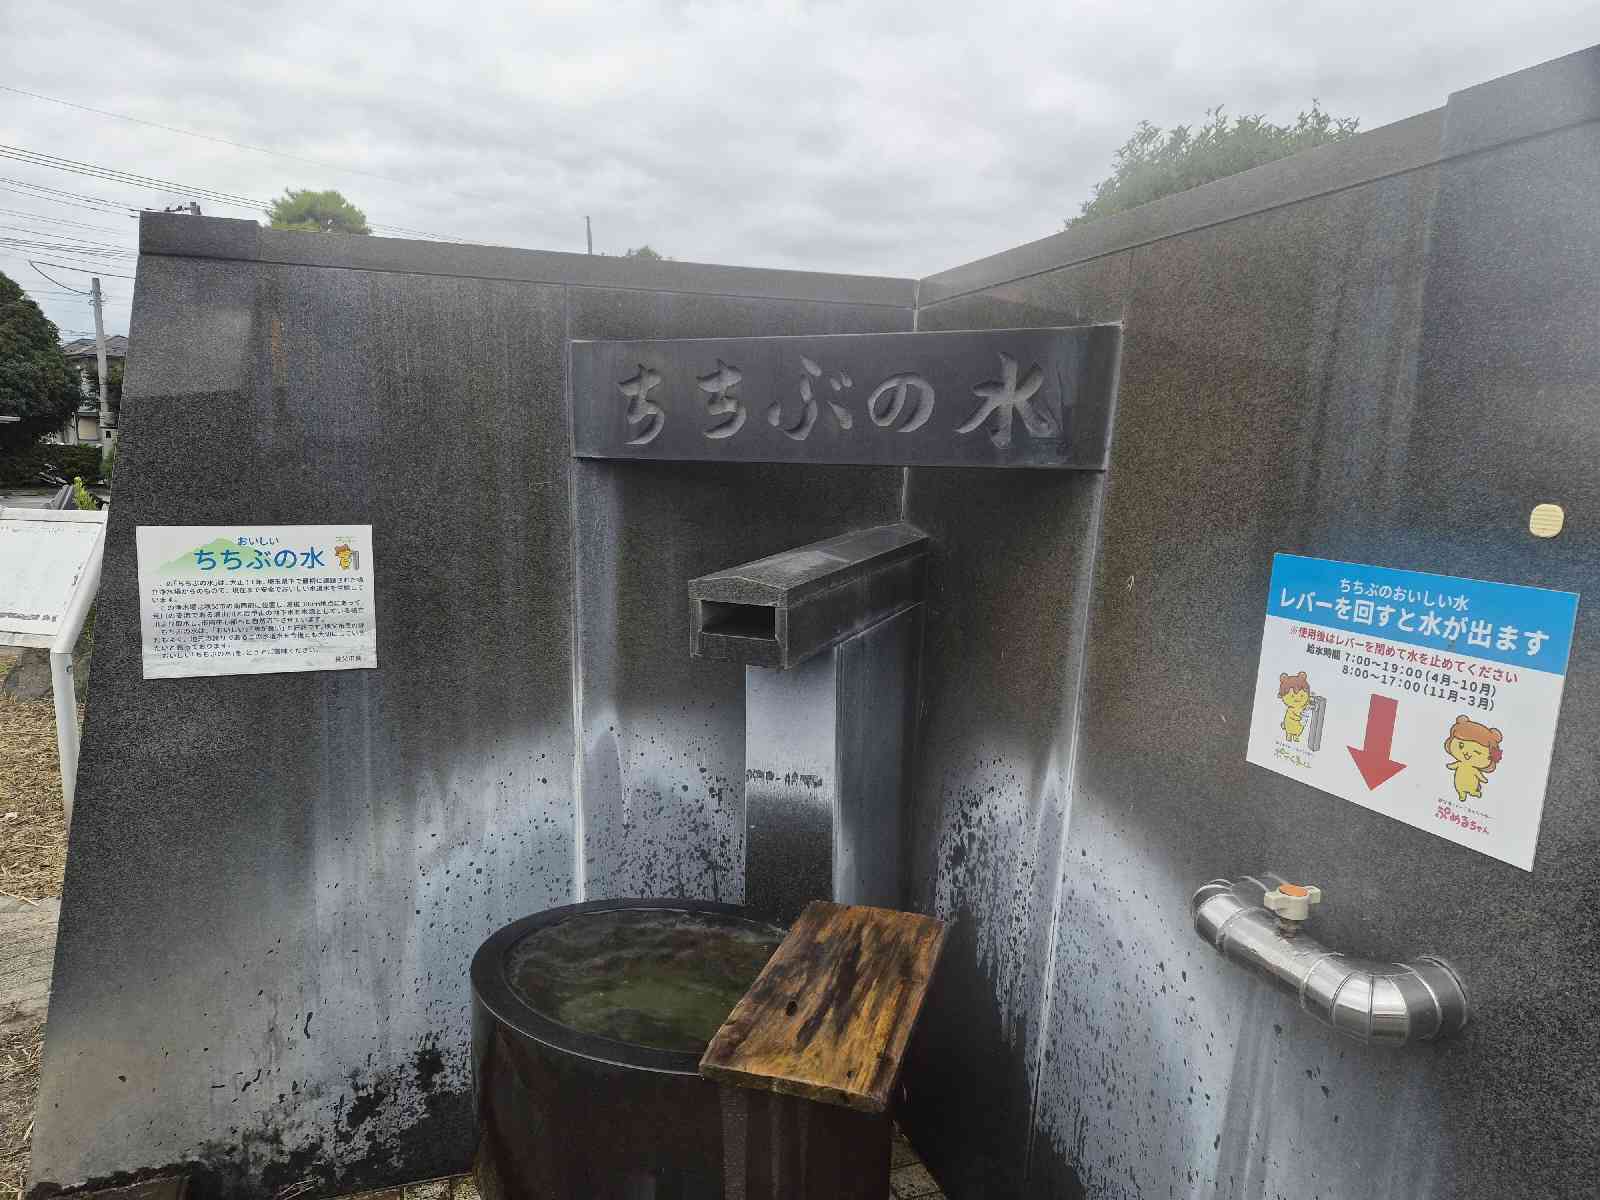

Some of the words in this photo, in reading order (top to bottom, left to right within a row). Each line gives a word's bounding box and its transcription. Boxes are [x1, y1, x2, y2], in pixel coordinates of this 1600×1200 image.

[618, 353, 1059, 448] ちちぶの水
[237, 536, 279, 546] おいしい
[193, 546, 325, 570] ちちぶの水
[1340, 578, 1469, 611] ちちぶのおいしい水
[1280, 588, 1550, 656] レバーを回すと水が出ます
